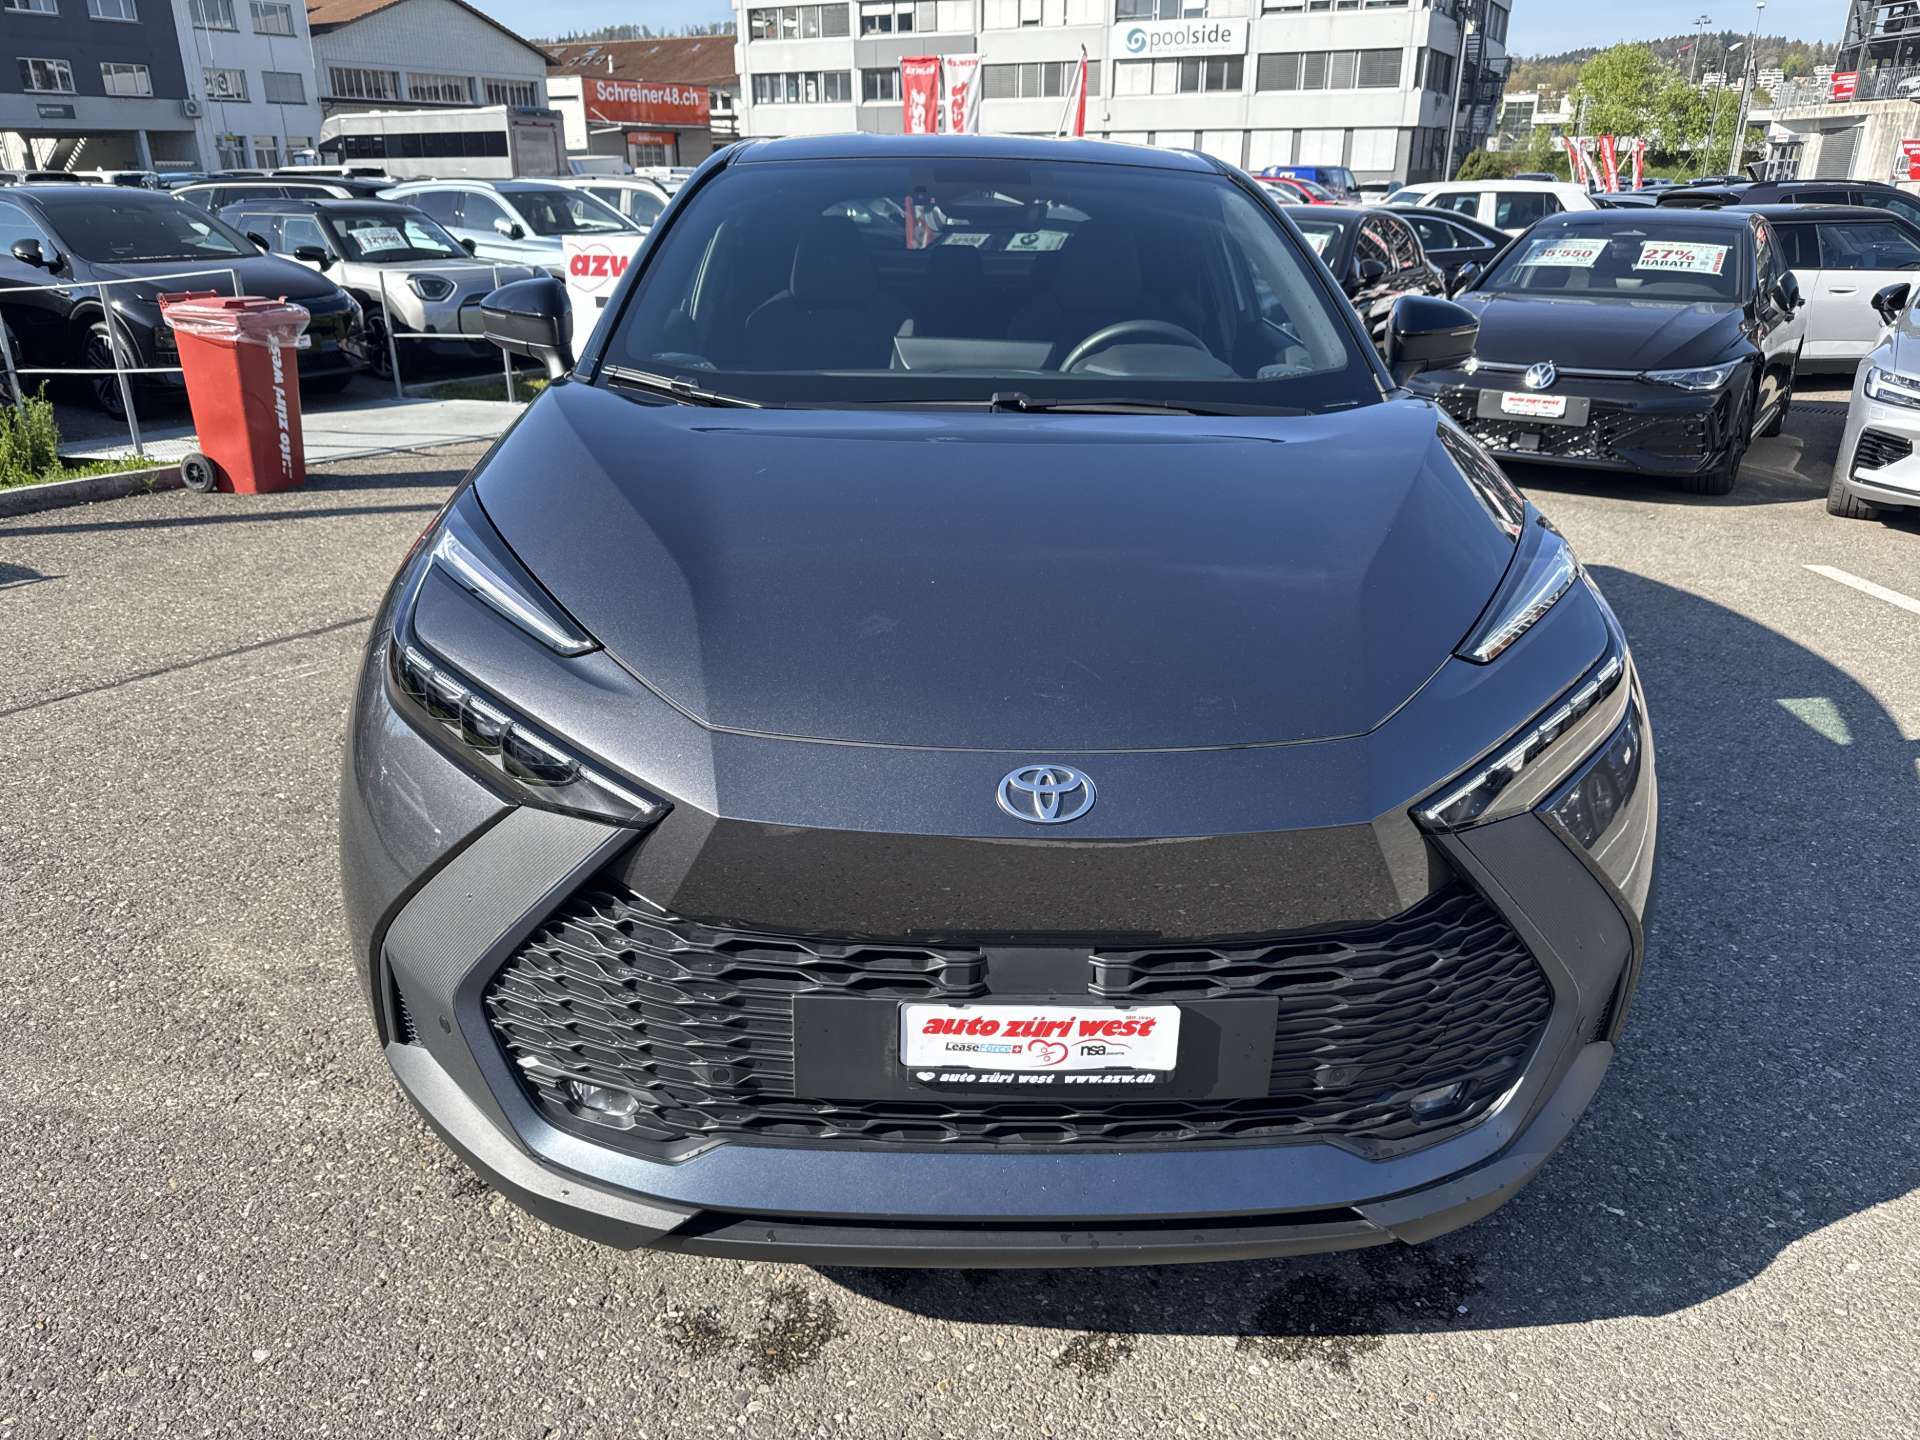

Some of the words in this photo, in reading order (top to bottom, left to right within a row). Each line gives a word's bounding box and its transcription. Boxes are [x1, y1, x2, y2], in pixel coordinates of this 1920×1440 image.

[1150, 23, 1231, 53] poolside
[596, 80, 699, 106] Schreiner48.ch
[911, 88, 926, 133] est
[952, 81, 968, 133] est
[570, 254, 629, 277] azw
[1643, 249, 1696, 261] 27%
[922, 1016, 1000, 1036] auto
[1001, 1016, 1077, 1038] züri
[1078, 1017, 1157, 1037] west
[945, 1041, 1012, 1054] LeaseForce
[1080, 1044, 1106, 1056] nsa
[940, 1073, 976, 1083] auto
[979, 1072, 1014, 1083] züri
[1018, 1073, 1055, 1083] west
[1064, 1073, 1156, 1084] www.azw.ch
